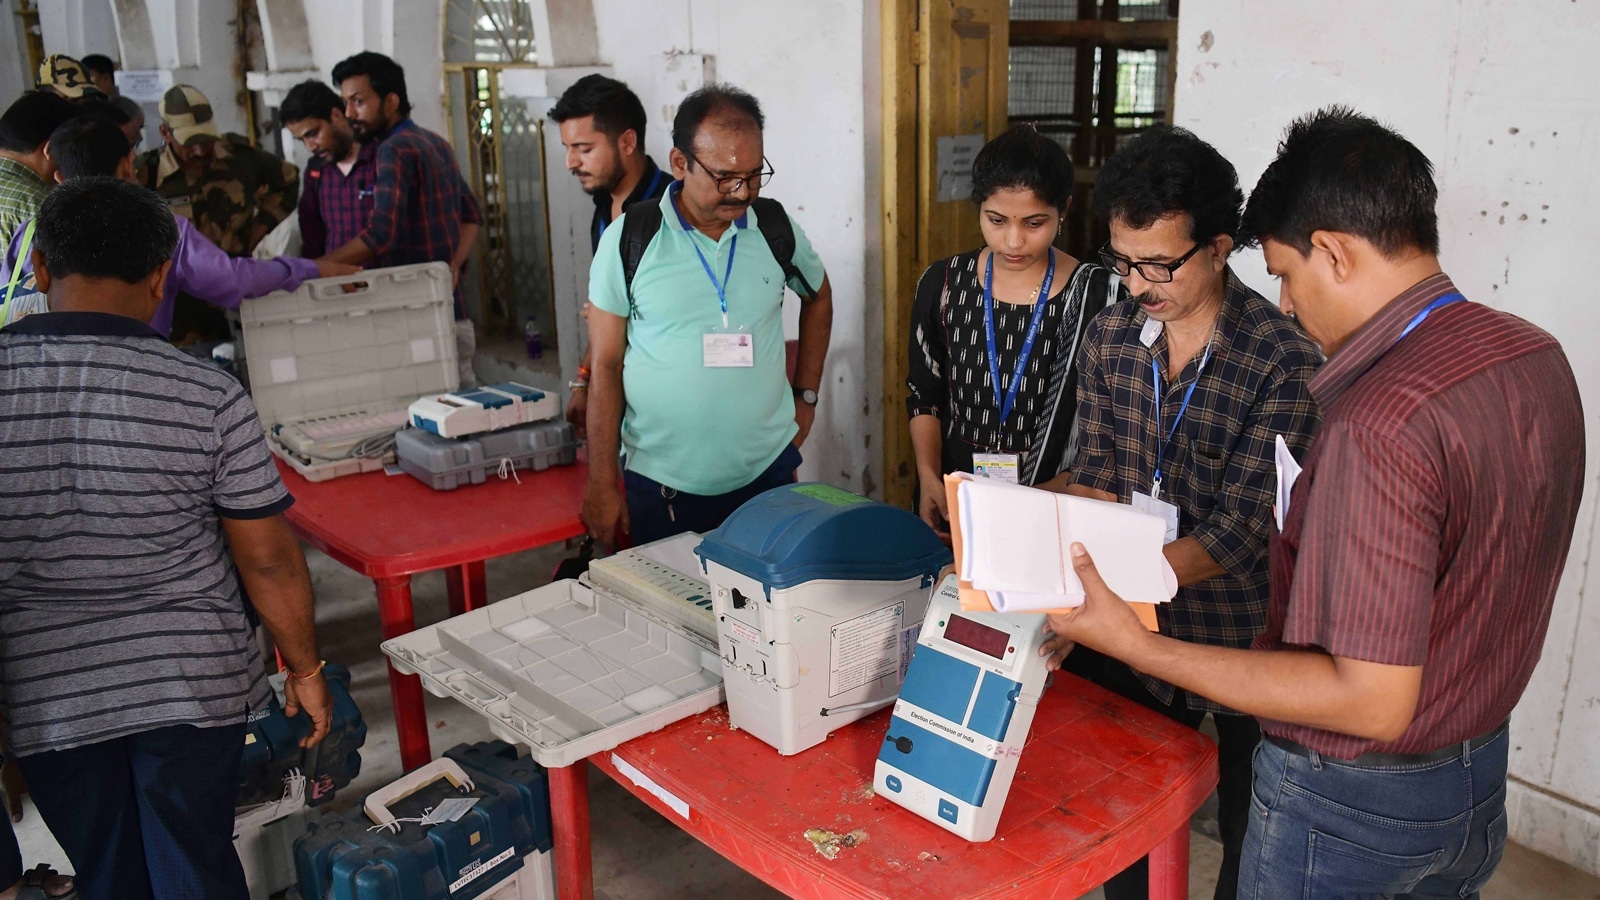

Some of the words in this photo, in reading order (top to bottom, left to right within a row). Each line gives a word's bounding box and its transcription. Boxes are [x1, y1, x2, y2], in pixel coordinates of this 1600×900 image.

[910, 711, 929, 723] Election
[928, 719, 957, 735] Commission
[962, 734, 975, 743] India
